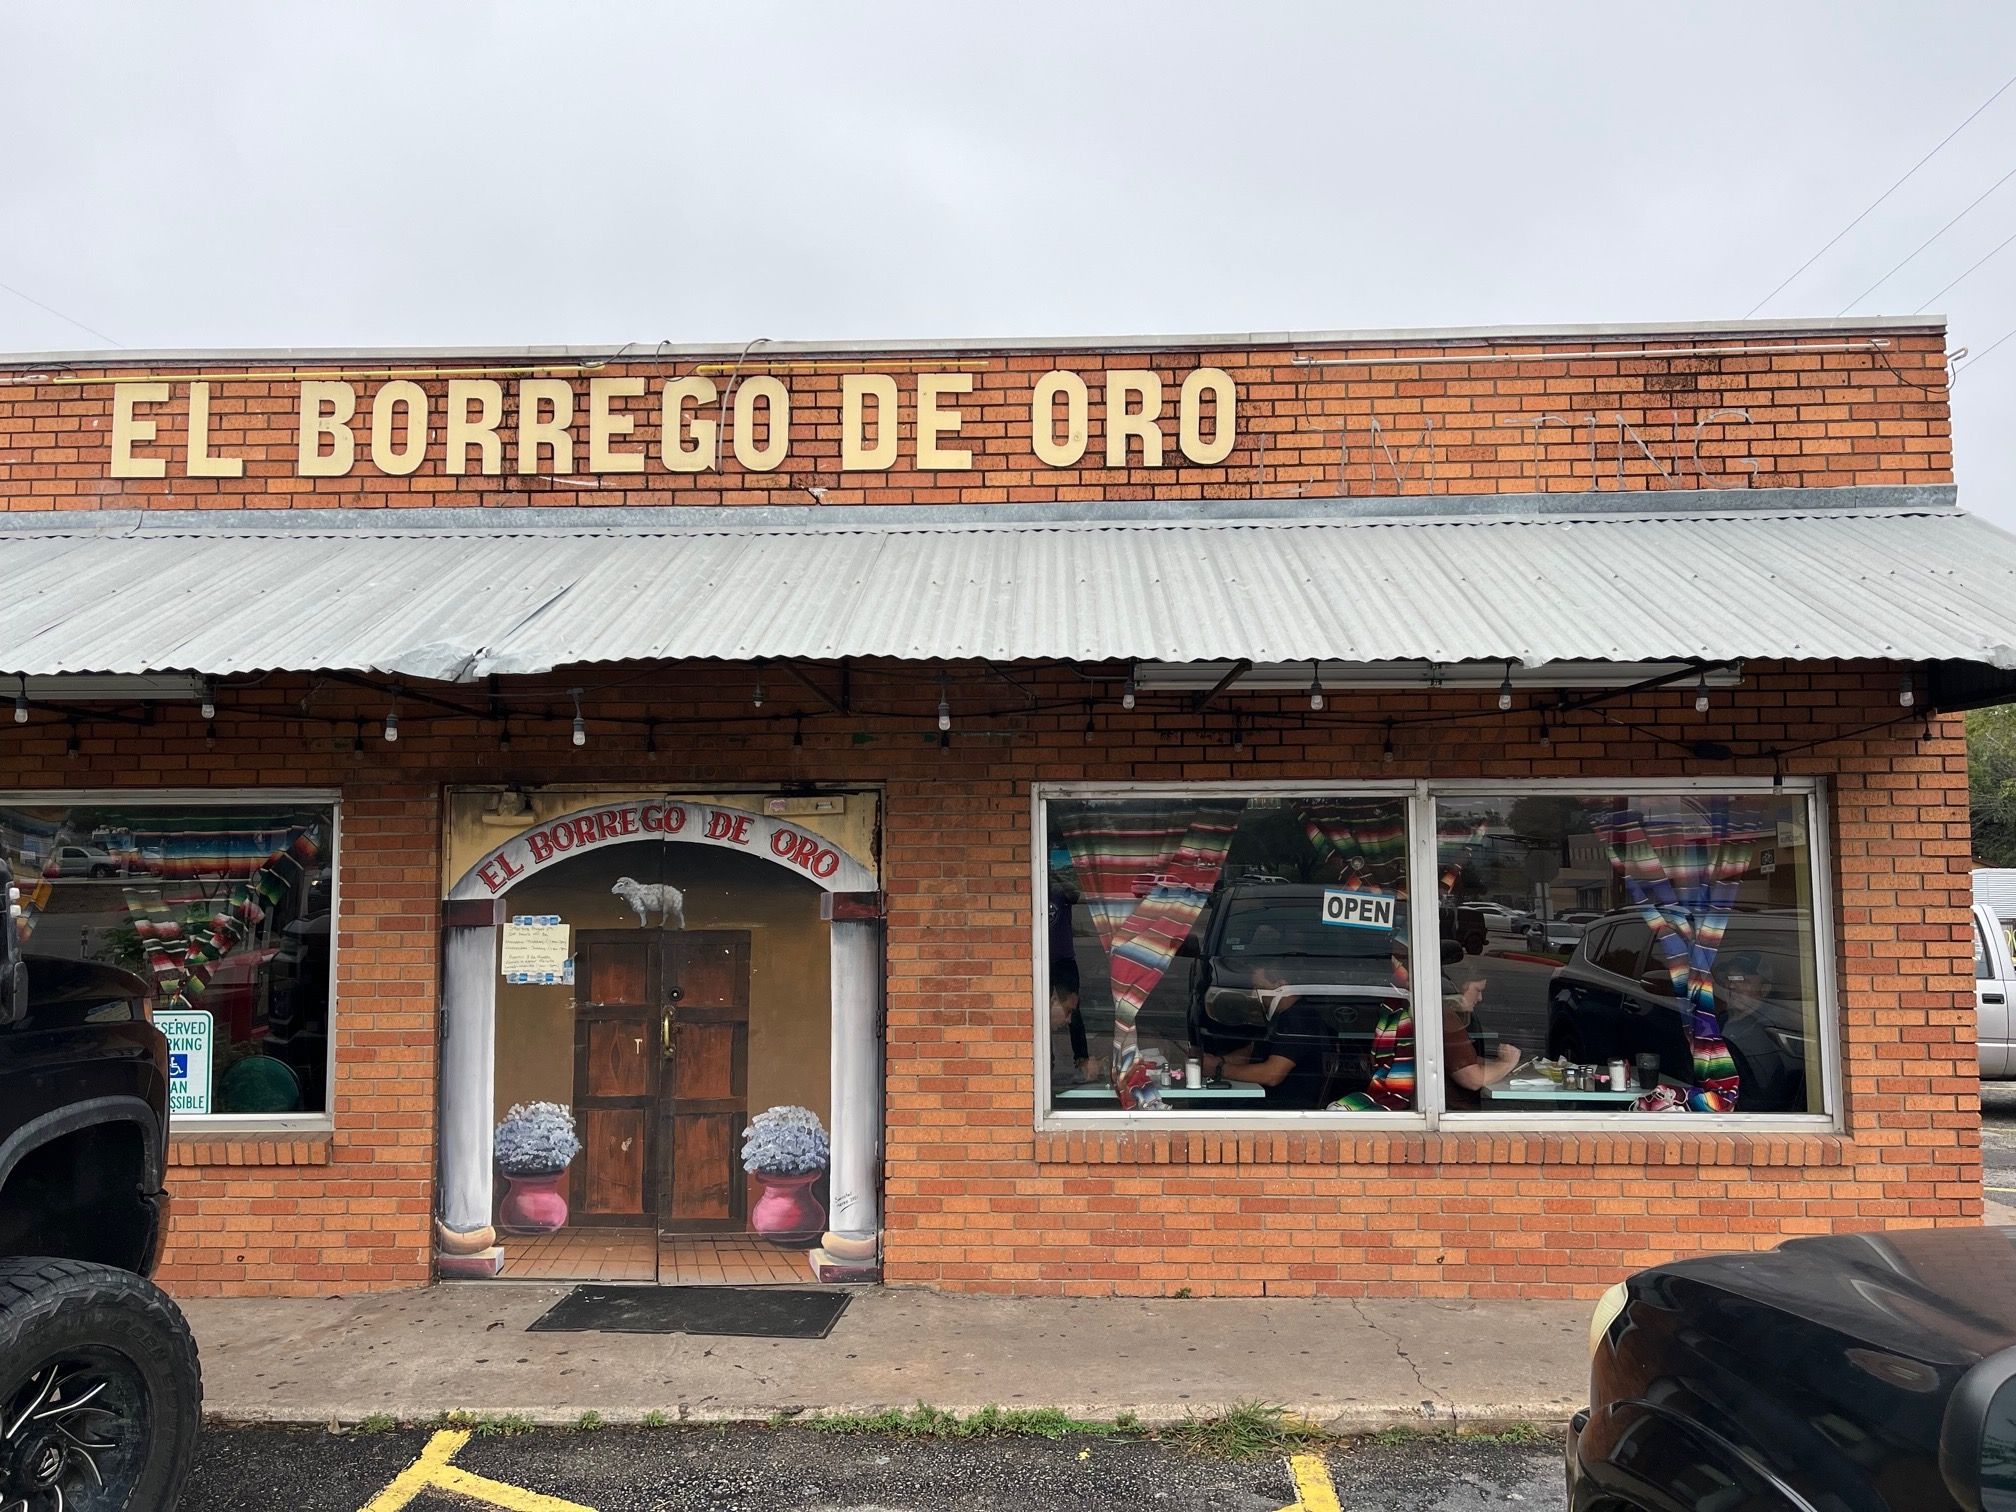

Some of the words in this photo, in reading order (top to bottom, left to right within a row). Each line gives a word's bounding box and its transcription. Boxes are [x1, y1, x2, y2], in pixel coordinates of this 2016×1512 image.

[110, 381, 243, 478] EL
[298, 375, 789, 478] BORREGO
[842, 373, 973, 471] DE
[1032, 367, 1236, 468] ORO
[476, 851, 524, 894] EL
[525, 805, 686, 864] BORREGO
[704, 811, 755, 845] DE
[771, 828, 840, 879] ORO
[1327, 896, 1391, 924] OPEN
[155, 1021, 206, 1035] SERVED
[167, 1038, 202, 1051] RKING
[170, 1081, 187, 1094] AN
[170, 1096, 204, 1109] SSIBLE
